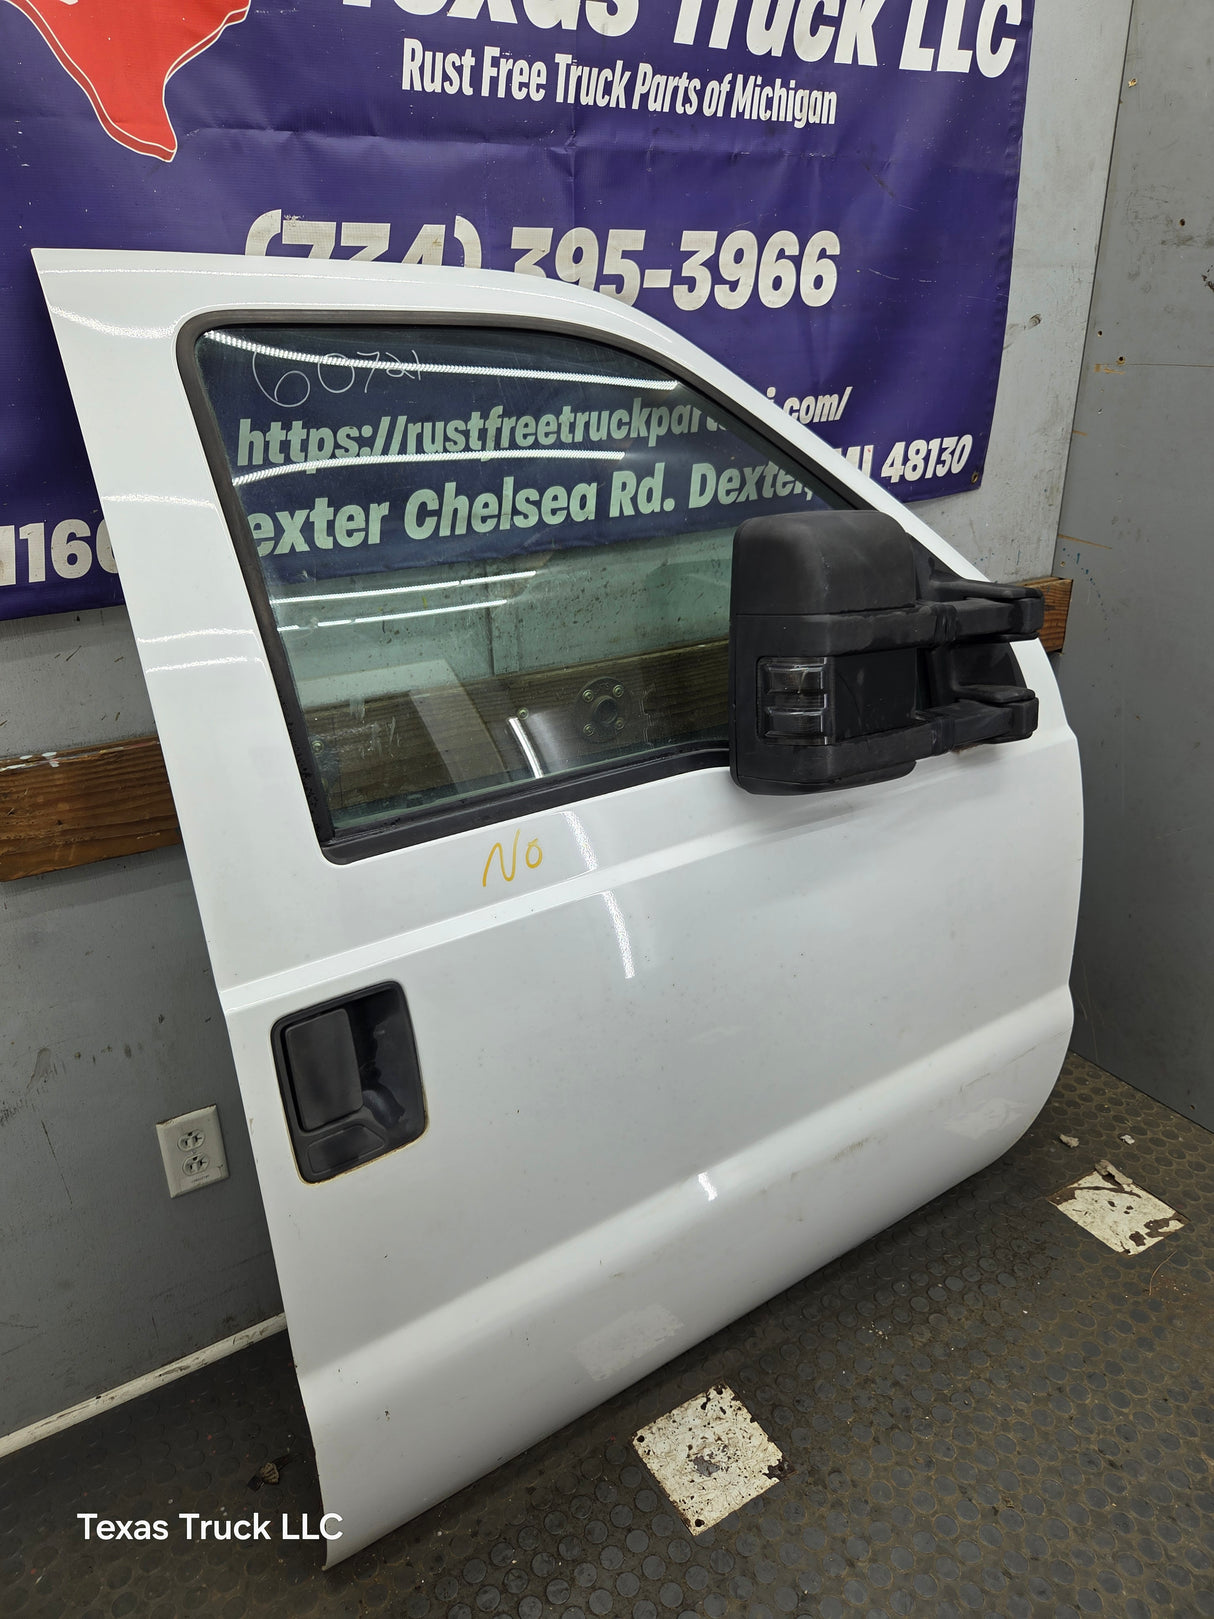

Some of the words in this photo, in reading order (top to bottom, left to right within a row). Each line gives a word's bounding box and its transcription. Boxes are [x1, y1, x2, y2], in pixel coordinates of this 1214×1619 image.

[899, 0, 1022, 78] LLC
[402, 38, 475, 95] Rust
[481, 46, 547, 101] Free
[555, 53, 631, 108] Truck
[632, 63, 700, 116] Parts
[702, 73, 731, 118] of
[731, 74, 838, 129] Michigan
[511, 227, 841, 311] 395-3966
[404, 476, 598, 540] Chelsea
[609, 462, 675, 518] Rd.
[881, 434, 973, 483] 48130
